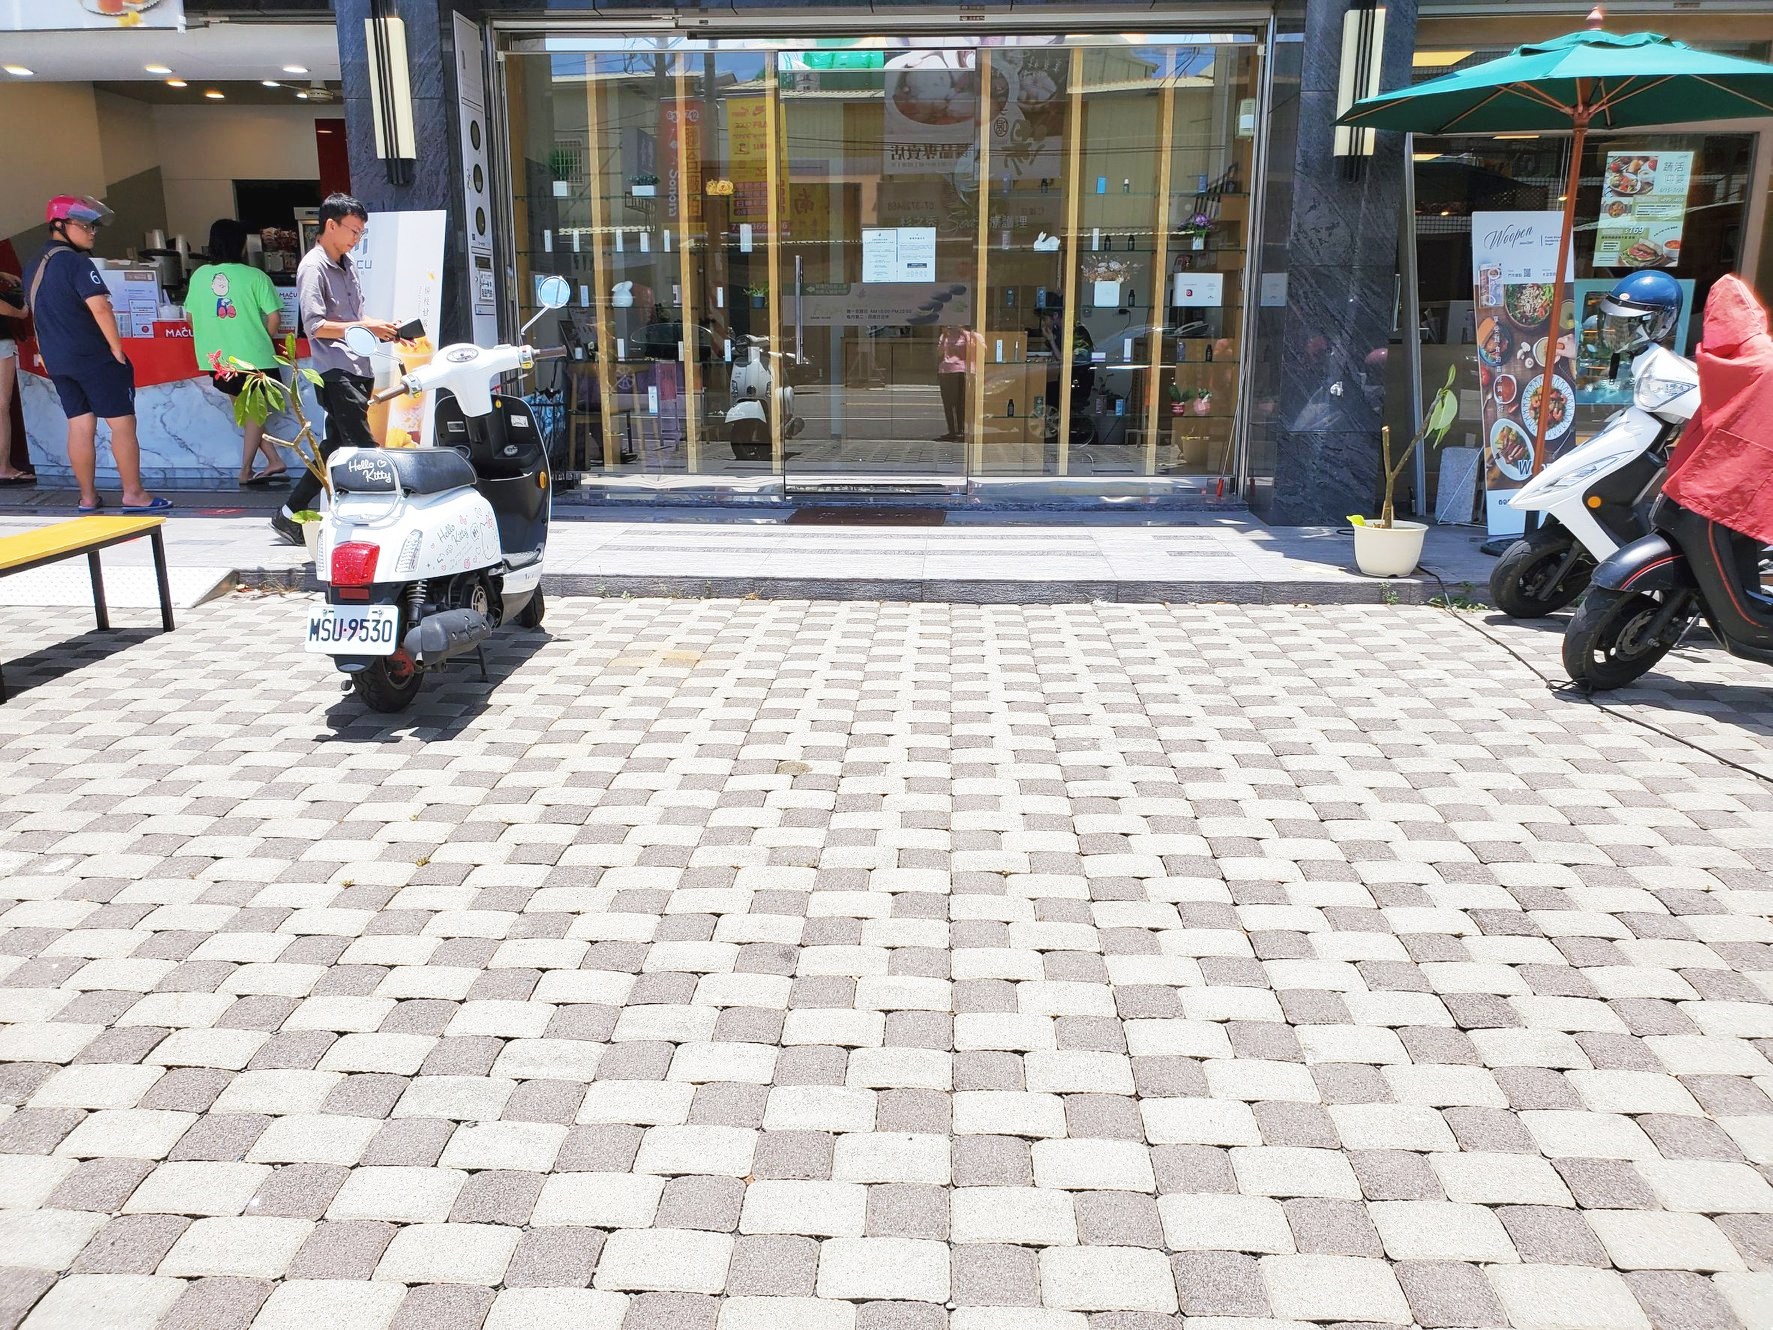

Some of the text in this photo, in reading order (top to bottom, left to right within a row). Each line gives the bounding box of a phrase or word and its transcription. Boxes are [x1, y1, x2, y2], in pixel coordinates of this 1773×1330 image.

[1484, 224, 1534, 250] Woopen
[90, 271, 100, 285] 6
[349, 459, 375, 472] Hello
[363, 469, 392, 483] Kitty
[437, 523, 455, 544] Hello
[451, 528, 469, 546] Kitty
